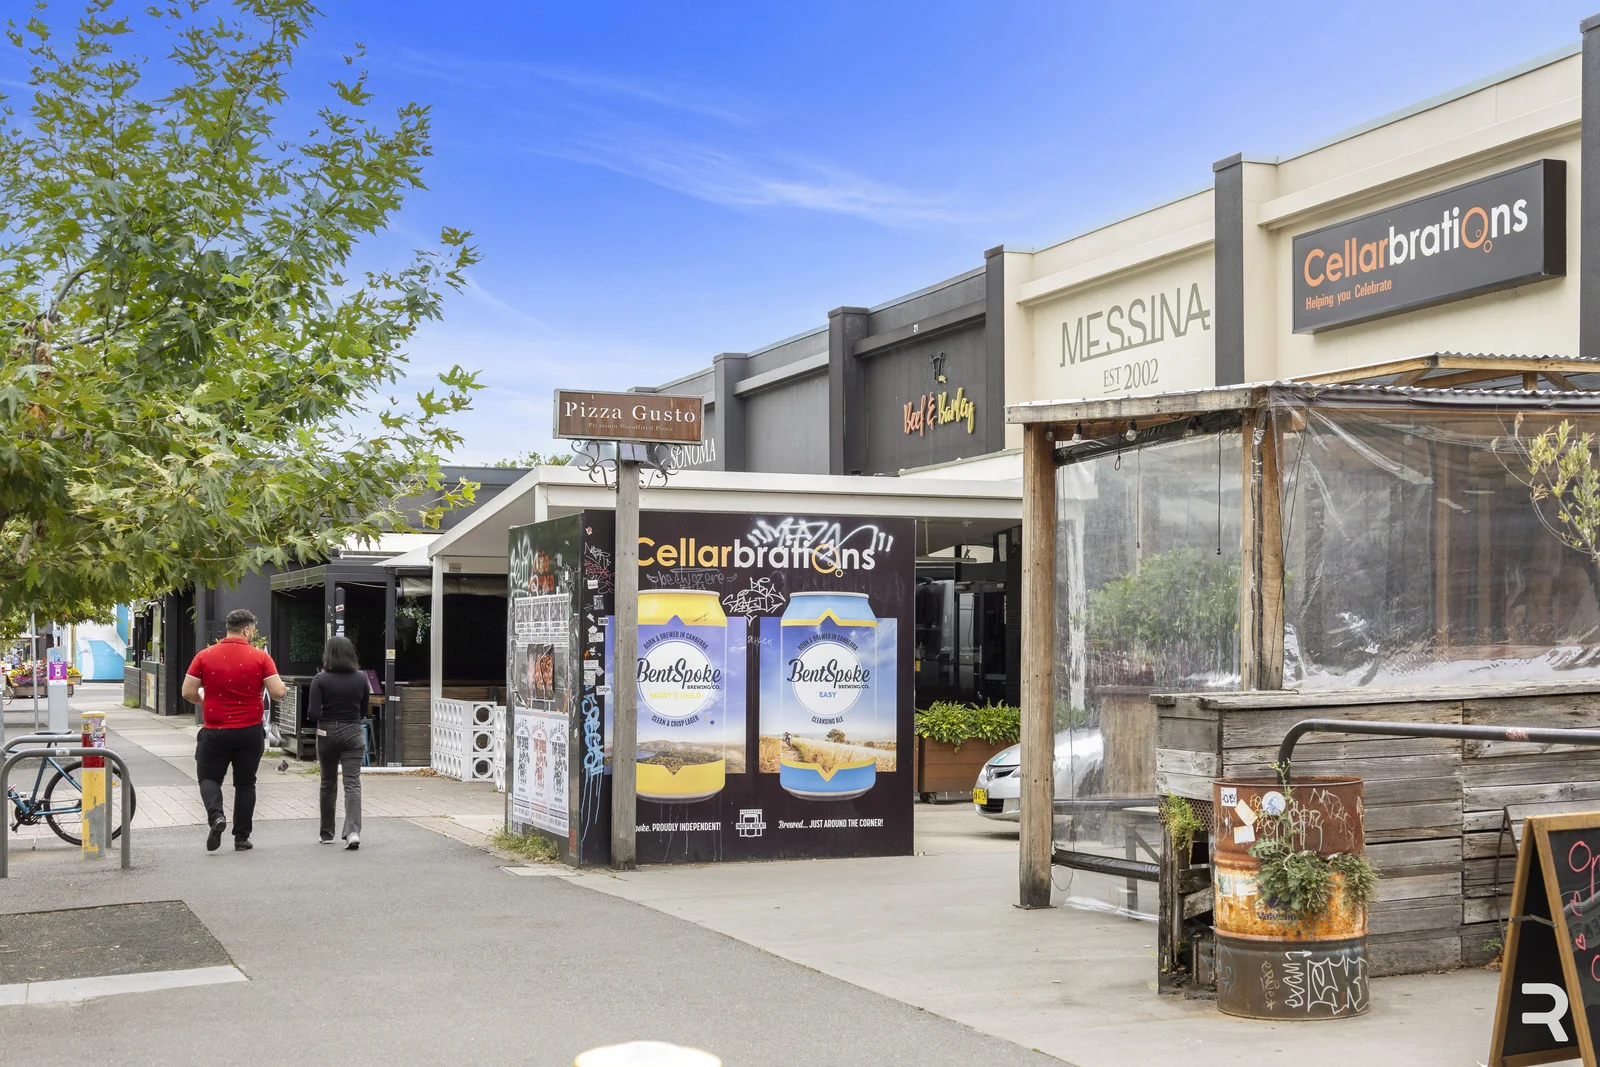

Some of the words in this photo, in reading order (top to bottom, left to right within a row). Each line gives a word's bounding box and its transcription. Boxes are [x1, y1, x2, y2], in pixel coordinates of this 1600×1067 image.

[1305, 294, 1334, 311] Helping
[1337, 289, 1351, 306] you
[1354, 279, 1393, 298] Celebrate
[1059, 283, 1211, 368] MESSINA
[1103, 366, 1122, 388] EST
[1124, 358, 1159, 390] 2002
[565, 401, 622, 418] Pizza
[632, 405, 695, 423] Gusto
[903, 394, 927, 437] Beef
[926, 391, 937, 431] &
[937, 387, 975, 434] Barley
[643, 638, 656, 650] BORN
[660, 631, 679, 639] BREWED
[685, 632, 709, 650] CANBERRA
[813, 633, 831, 641] BREWED
[837, 634, 858, 651] CANBERRA
[637, 657, 722, 690] BentSpoke
[786, 658, 871, 689] BentSpoke
[651, 714, 666, 726] CLEAN
[671, 719, 685, 727] CRISP
[685, 714, 700, 726] LAGER
[811, 716, 835, 725] CLEANSING
[836, 716, 844, 724] ALE
[652, 822, 678, 832] PROUDLY
[680, 822, 722, 831] INDEPENDENT!
[809, 820, 823, 828] JUST
[824, 819, 847, 828] AROUND
[848, 819, 859, 828] THE
[860, 818, 884, 827] CORNER!
